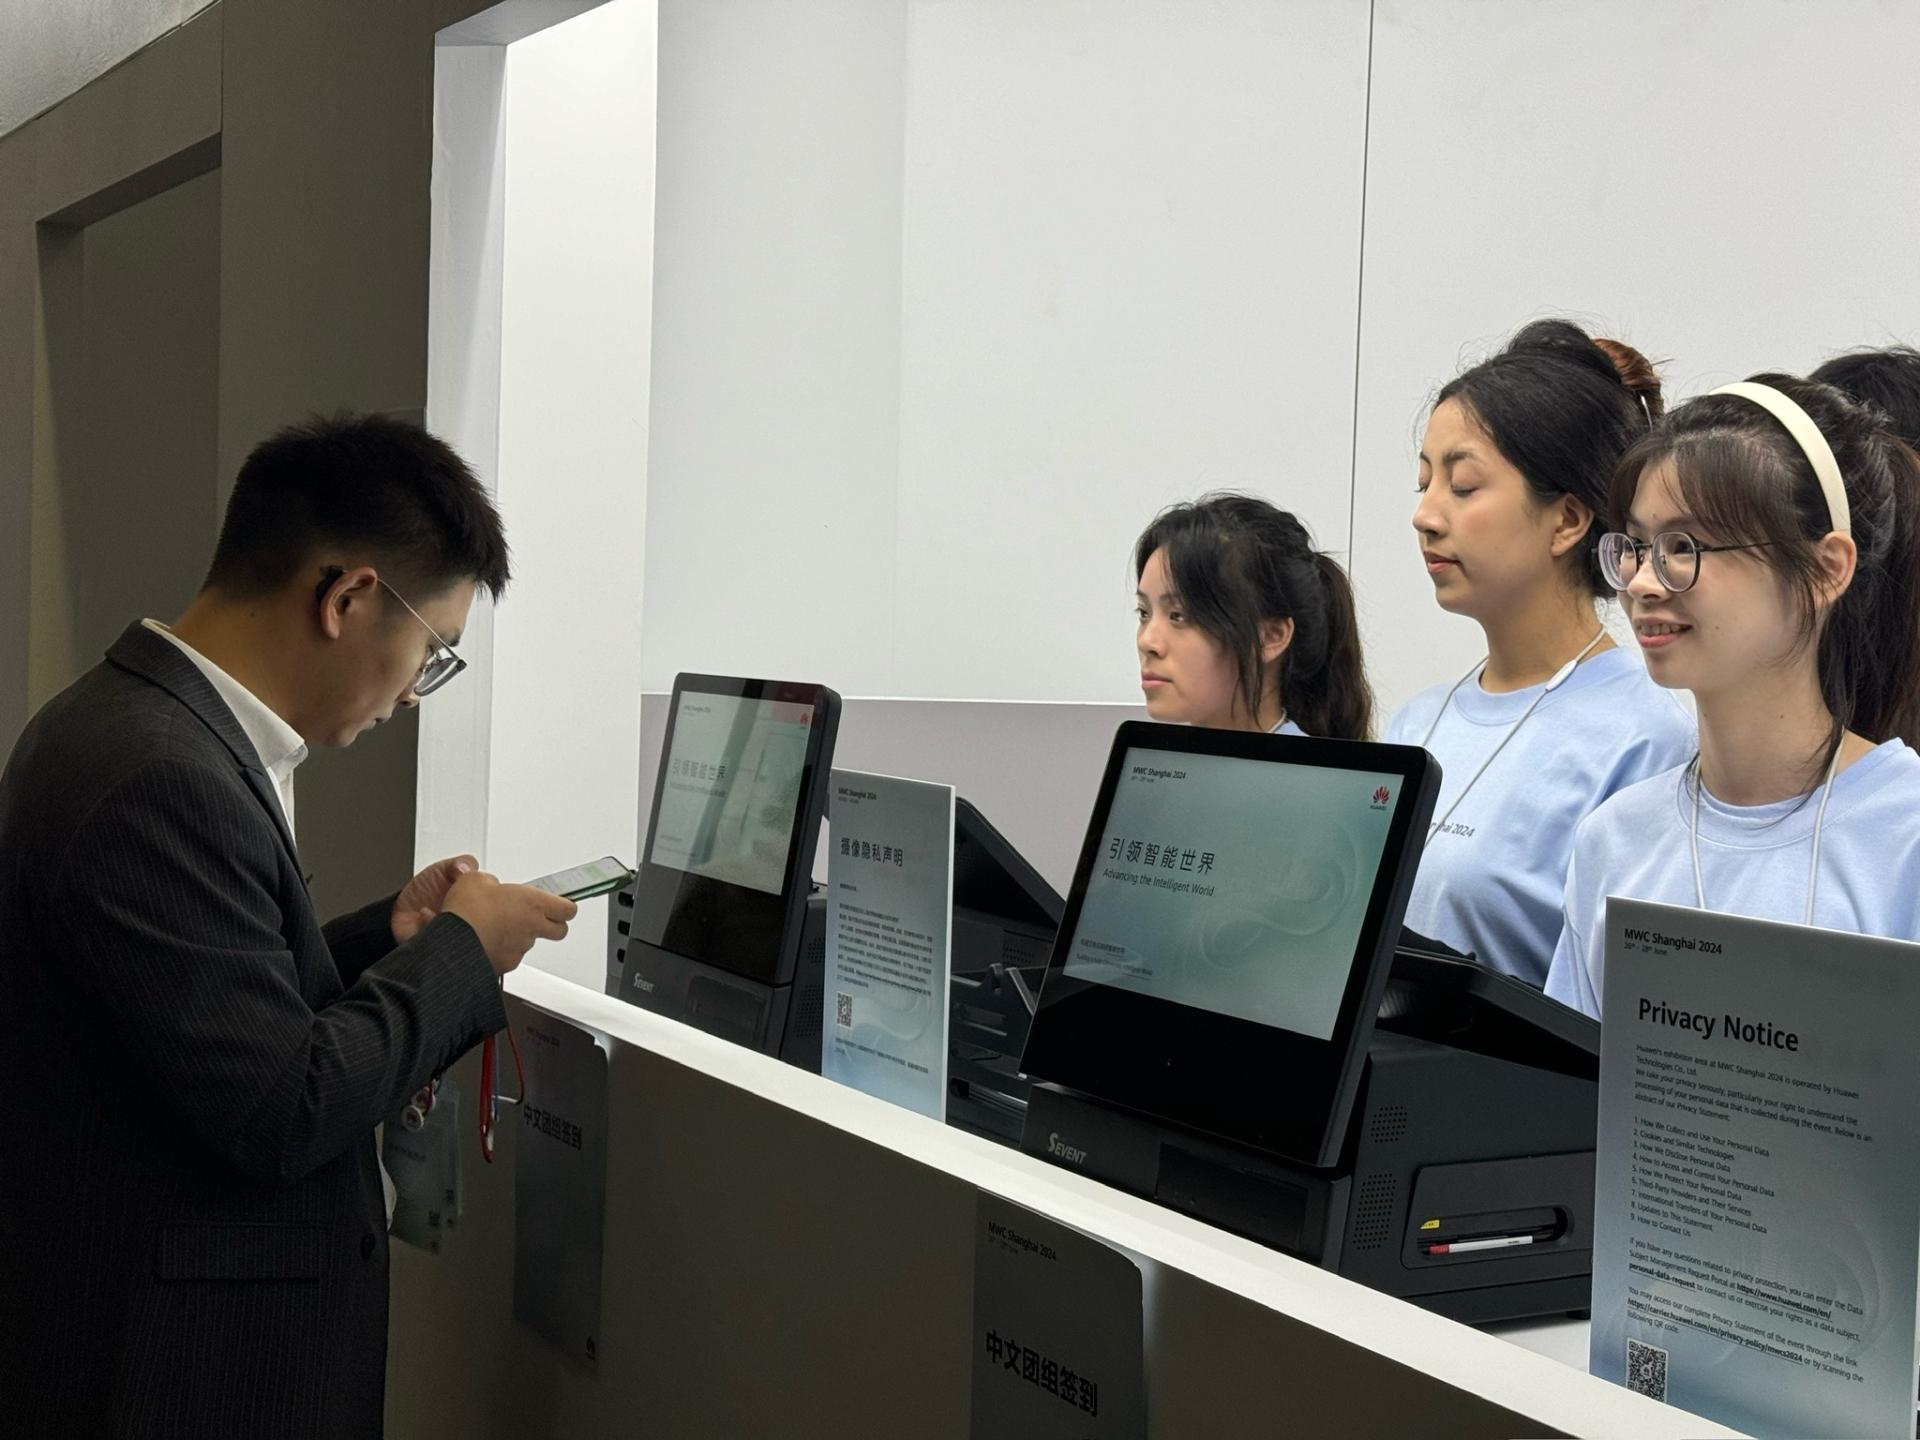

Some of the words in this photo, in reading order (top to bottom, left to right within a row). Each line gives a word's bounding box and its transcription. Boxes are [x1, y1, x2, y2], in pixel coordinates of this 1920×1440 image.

[1133, 766, 1147, 775] MWC
[1172, 770, 1186, 779] 2024
[1452, 823, 1475, 838] 2024
[1109, 837, 1216, 875] 引领智能世界
[1102, 869, 1138, 886] Advancing
[1139, 872, 1152, 887] the
[1153, 874, 1190, 893] Intelligent
[1191, 881, 1216, 897] World
[1624, 927, 1650, 942] MWC
[1651, 932, 1696, 950] Shanghai
[1698, 940, 1722, 954] 2024
[1639, 997, 1715, 1040] Privacy
[1723, 1014, 1798, 1051] Notice
[1663, 1050, 1692, 1061] exhibition
[1694, 1057, 1707, 1066] area
[1717, 1060, 1734, 1072] MWC
[1735, 1064, 1765, 1078] Shanghai
[1767, 1071, 1783, 1082] 2024
[1791, 1079, 1821, 1090] operated
[1833, 1087, 1859, 1099] Huawei
[524, 1102, 582, 1151] 中文团组签到
[1634, 1080, 1665, 1095] processing
[1674, 1090, 1687, 1098] your
[1688, 1093, 1713, 1105] personal
[1714, 1099, 1728, 1108] data
[1730, 1102, 1742, 1112] that
[1750, 1108, 1778, 1120] collected
[1778, 1114, 1799, 1127] during
[1800, 1119, 1812, 1128] the
[1834, 1126, 1854, 1138] Below
[1639, 1129, 1662, 1141] Cookies
[1662, 1136, 1674, 1145] and
[1675, 1138, 1695, 1150] Similar
[1697, 1144, 1734, 1160] Technologies
[1640, 1118, 1653, 1127] How
[1665, 1124, 1685, 1135] Collect
[1699, 1132, 1711, 1142] Use
[1711, 1135, 1725, 1145] Your
[1726, 1139, 1752, 1152] Personal
[1754, 1146, 1769, 1157] Data
[1638, 1154, 1652, 1163] How
[1660, 1160, 1680, 1171] Access
[1681, 1167, 1692, 1175] and
[1693, 1168, 1715, 1181] Control
[1717, 1175, 1730, 1184] Your
[1731, 1178, 1758, 1192] Personal
[1759, 1186, 1774, 1197] Data
[1639, 1142, 1652, 1151] How
[1664, 1148, 1688, 1161] Disclose
[1689, 1154, 1714, 1168] Personal
[1715, 1161, 1730, 1172] Data
[1638, 1166, 1652, 1176] How
[1664, 1173, 1684, 1184] Protect
[1686, 1180, 1699, 1189] Your
[1700, 1182, 1725, 1196] Personal
[1726, 1190, 1741, 1200] Data
[1670, 1187, 1696, 1201] Providers
[1698, 1196, 1709, 1204] and
[1711, 1198, 1726, 1208] Their
[1727, 1203, 1751, 1216] Services
[1637, 1190, 1673, 1207] International
[1675, 1200, 1700, 1214] Transfers
[1709, 1210, 1723, 1221] Your
[1724, 1215, 1750, 1229] Personal
[1751, 1223, 1767, 1233] Data
[1637, 1202, 1660, 1216] Updates
[1670, 1211, 1681, 1222] This
[1682, 1215, 1712, 1231] Statement
[1637, 1215, 1650, 1224] How
[1659, 1221, 1681, 1234] Contact
[988, 1221, 1006, 1239] MWC
[1008, 1230, 1039, 1252] Shanghai
[1039, 1243, 1057, 1261] 2024
[1629, 1249, 1648, 1261] Subject
[1649, 1255, 1686, 1273] Management
[1687, 1267, 1710, 1280] Request
[1710, 1274, 1728, 1286] Portal
[1635, 1240, 1645, 1248] you
[1646, 1242, 1660, 1252] have
[1661, 1248, 1672, 1258] any
[1673, 1252, 1701, 1265] questions
[1702, 1260, 1723, 1272] related
[1732, 1269, 1753, 1283] privacy
[1788, 1288, 1801, 1296] you
[1802, 1291, 1814, 1300] can
[1815, 1295, 1832, 1305] enter
[1834, 1300, 1845, 1310] the
[1846, 1303, 1863, 1315] Data
[1628, 1286, 1638, 1295] You
[1639, 1290, 1652, 1301] may
[1653, 1295, 1671, 1305] access
[1672, 1301, 1683, 1309] our
[1683, 1304, 1710, 1319] complete
[1712, 1312, 1733, 1327] Privacy
[1734, 1320, 1765, 1337] Statement
[1774, 1334, 1785, 1344] the
[1786, 1339, 1804, 1350] event
[1805, 1344, 1831, 1359] through
[1833, 1353, 1844, 1362] the
[1704, 1286, 1726, 1298] contact
[1744, 1299, 1768, 1312] exercise
[1769, 1307, 1783, 1316] your
[1785, 1312, 1803, 1323] rights
[1819, 1322, 1834, 1333] data
[986, 1330, 1099, 1418] 中文团组签到
[1821, 1363, 1850, 1379] scanning
[1852, 1373, 1864, 1382] the
